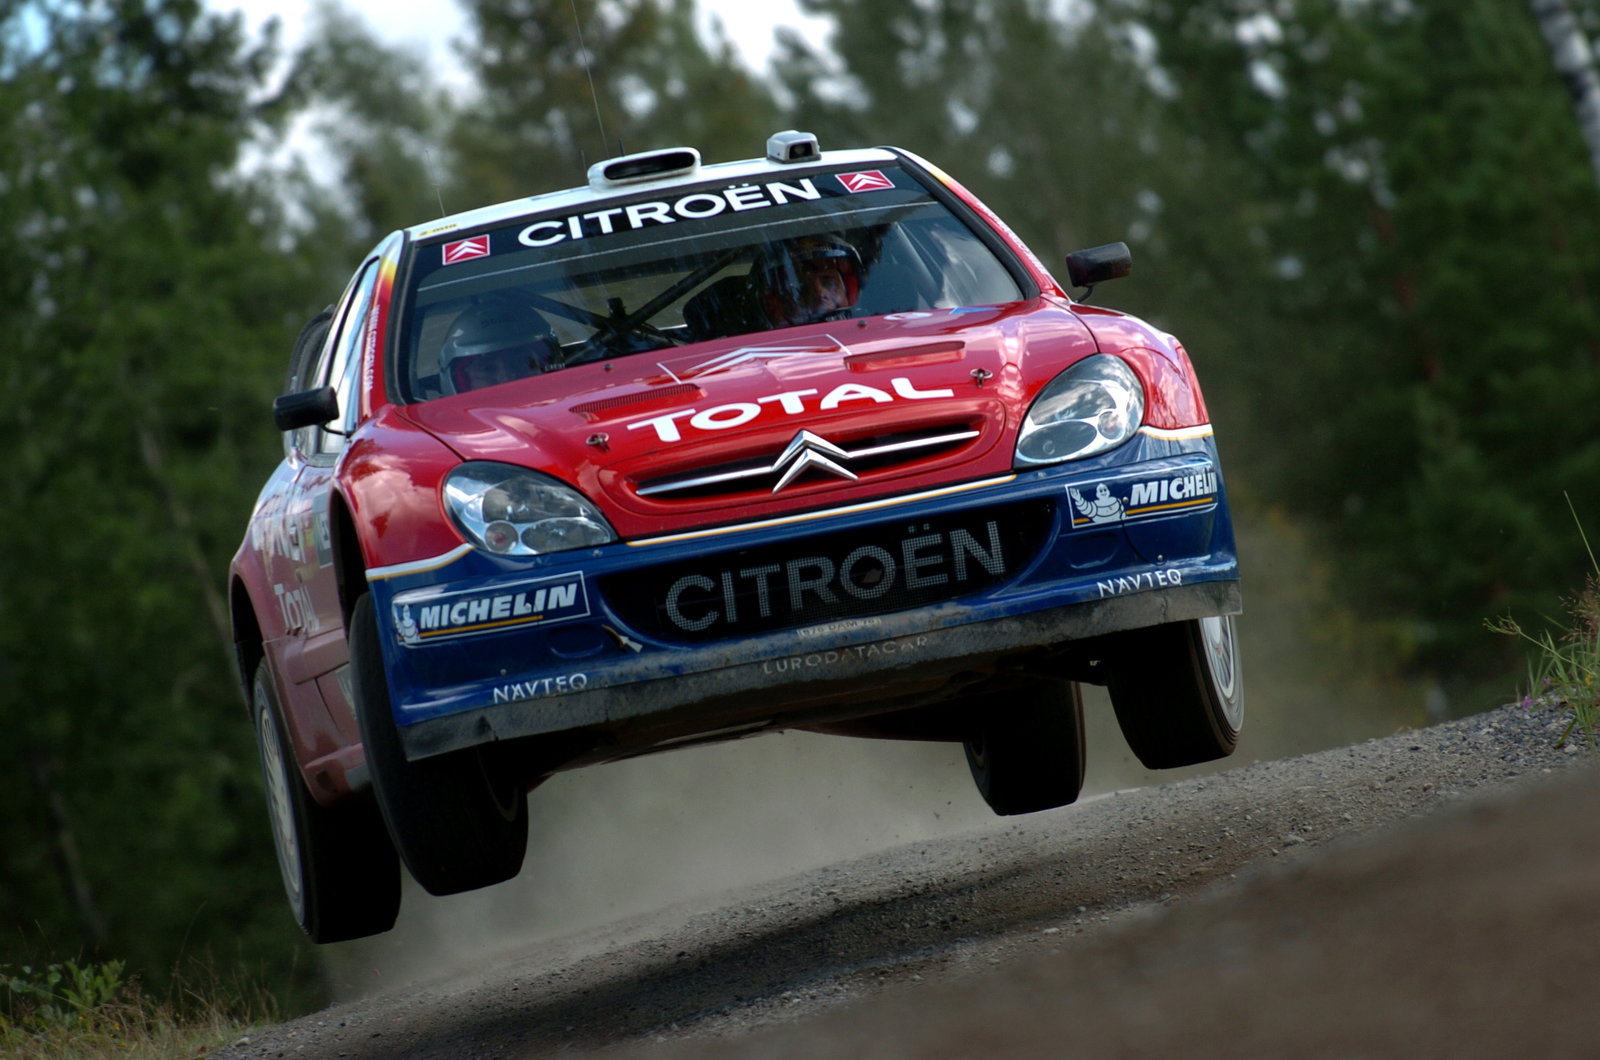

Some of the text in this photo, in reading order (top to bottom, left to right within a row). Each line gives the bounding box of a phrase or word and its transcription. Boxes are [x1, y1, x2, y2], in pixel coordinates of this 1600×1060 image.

[518, 178, 821, 248] CITROËN
[627, 377, 954, 442] TOTAL
[1130, 472, 1218, 506] MICHELIN
[665, 519, 1006, 632] CITROËN
[1097, 568, 1182, 598] NAVTEQ
[420, 583, 578, 629] MICHELIN
[493, 673, 588, 704] NAVTEQ
